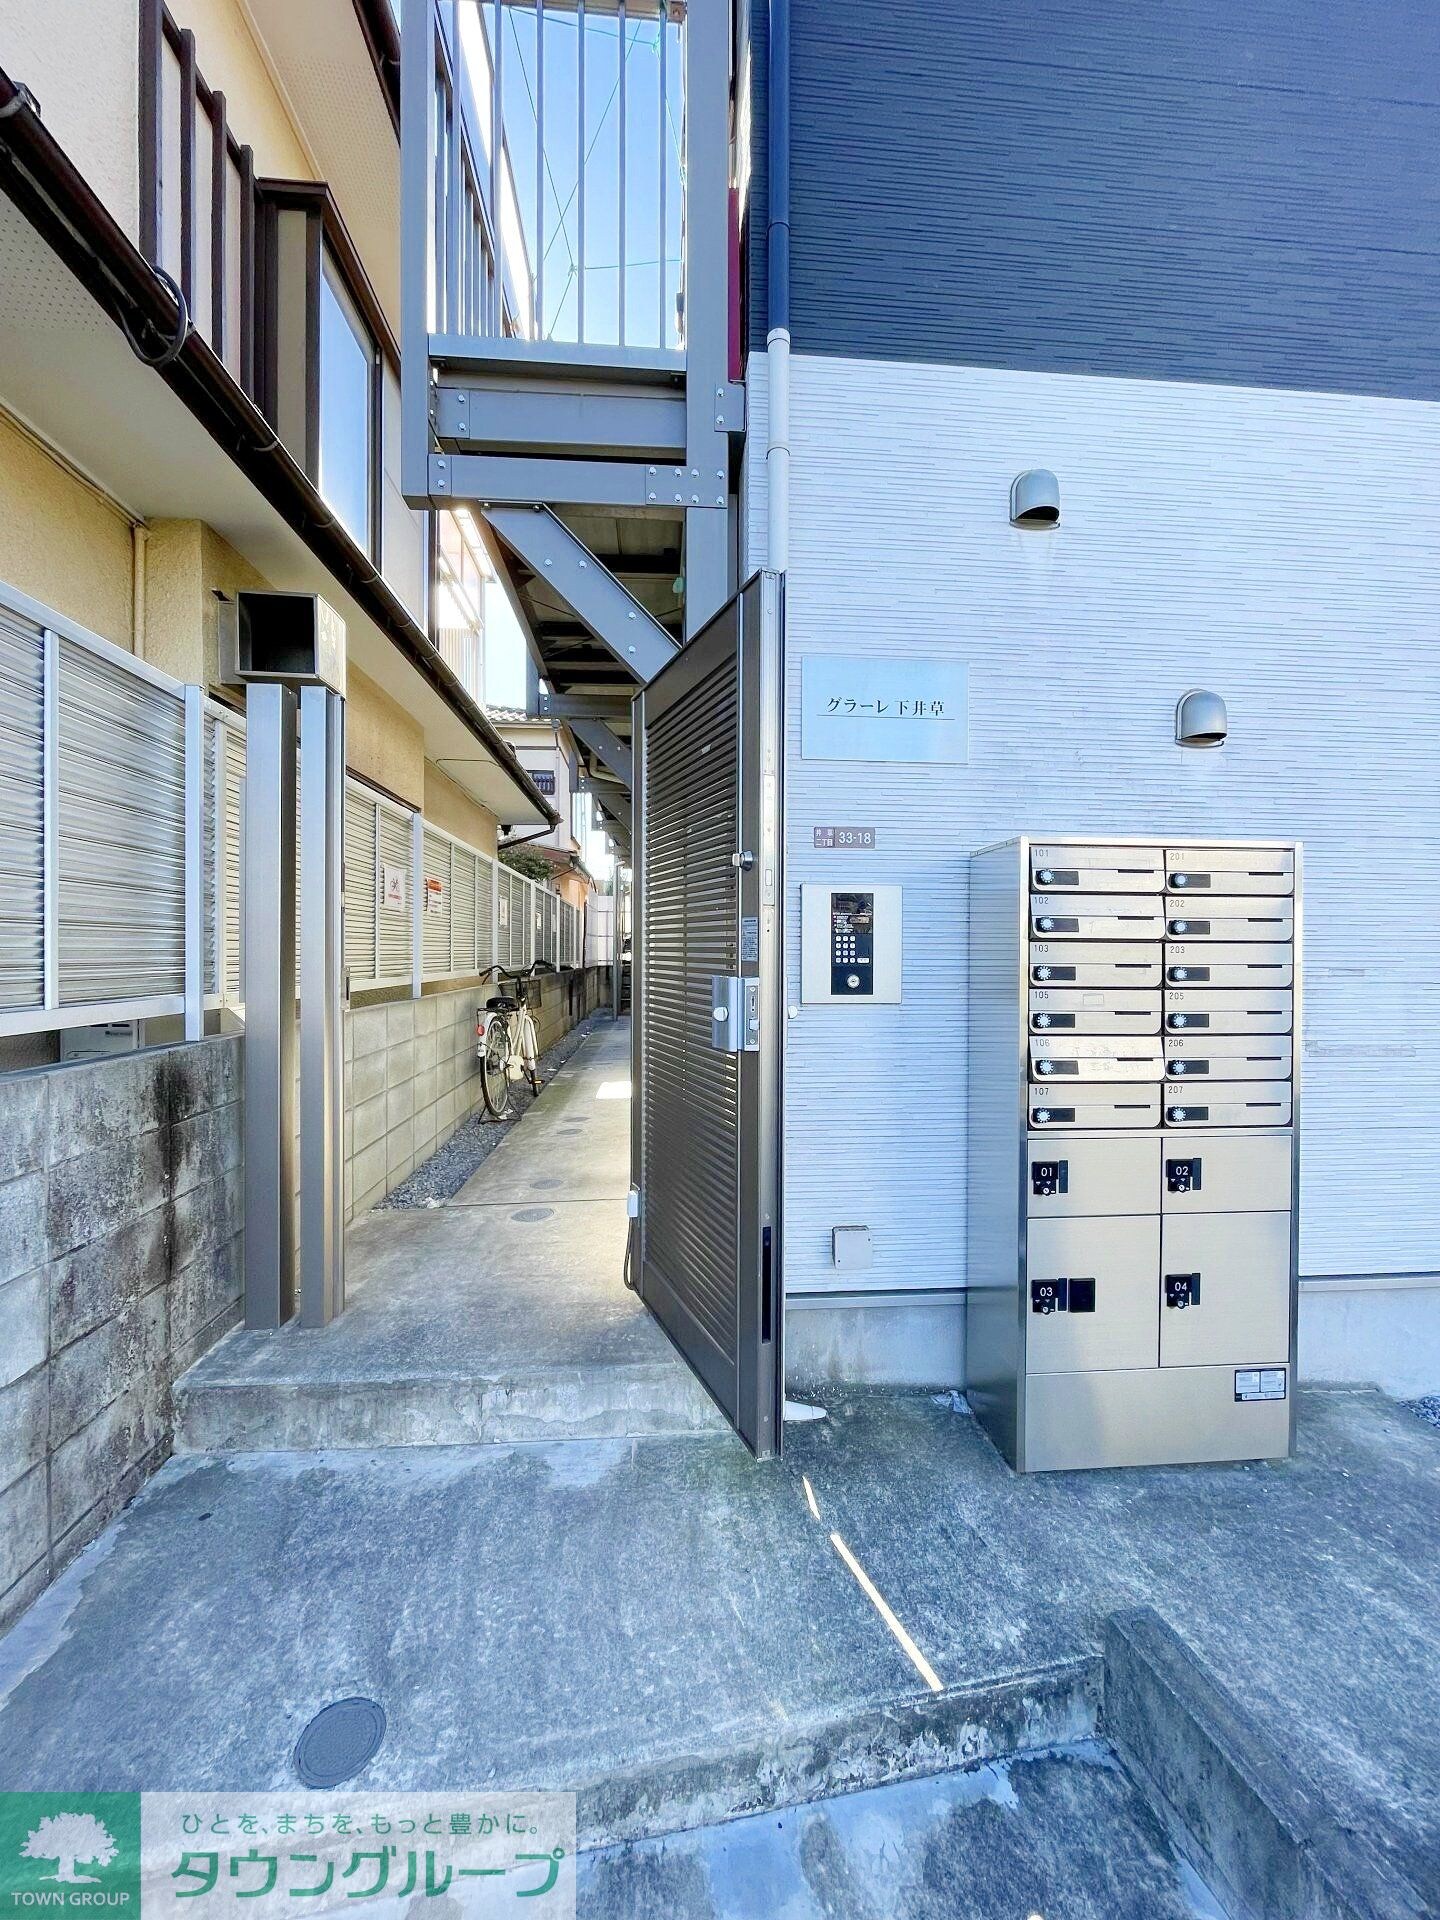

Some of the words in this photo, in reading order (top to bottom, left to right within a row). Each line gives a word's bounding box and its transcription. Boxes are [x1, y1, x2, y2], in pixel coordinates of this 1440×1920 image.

[838, 832, 871, 844] 33-18
[1034, 849, 1049, 857] 101
[1170, 853, 1185, 861] 201
[1034, 897, 1049, 905] 102
[1170, 900, 1185, 908] 202
[1034, 944, 1049, 953] 103
[1170, 946, 1185, 954] 203
[1034, 991, 1049, 999] 105
[1035, 1039, 1049, 1047] 106
[1168, 1039, 1184, 1047] 206
[1034, 1087, 1049, 1095] 107
[1168, 1086, 1183, 1094] 207
[1041, 1167, 1053, 1176] 01
[1175, 1166, 1189, 1175] 02
[1175, 1282, 1187, 1291] 04
[1040, 1287, 1053, 1297] 03
